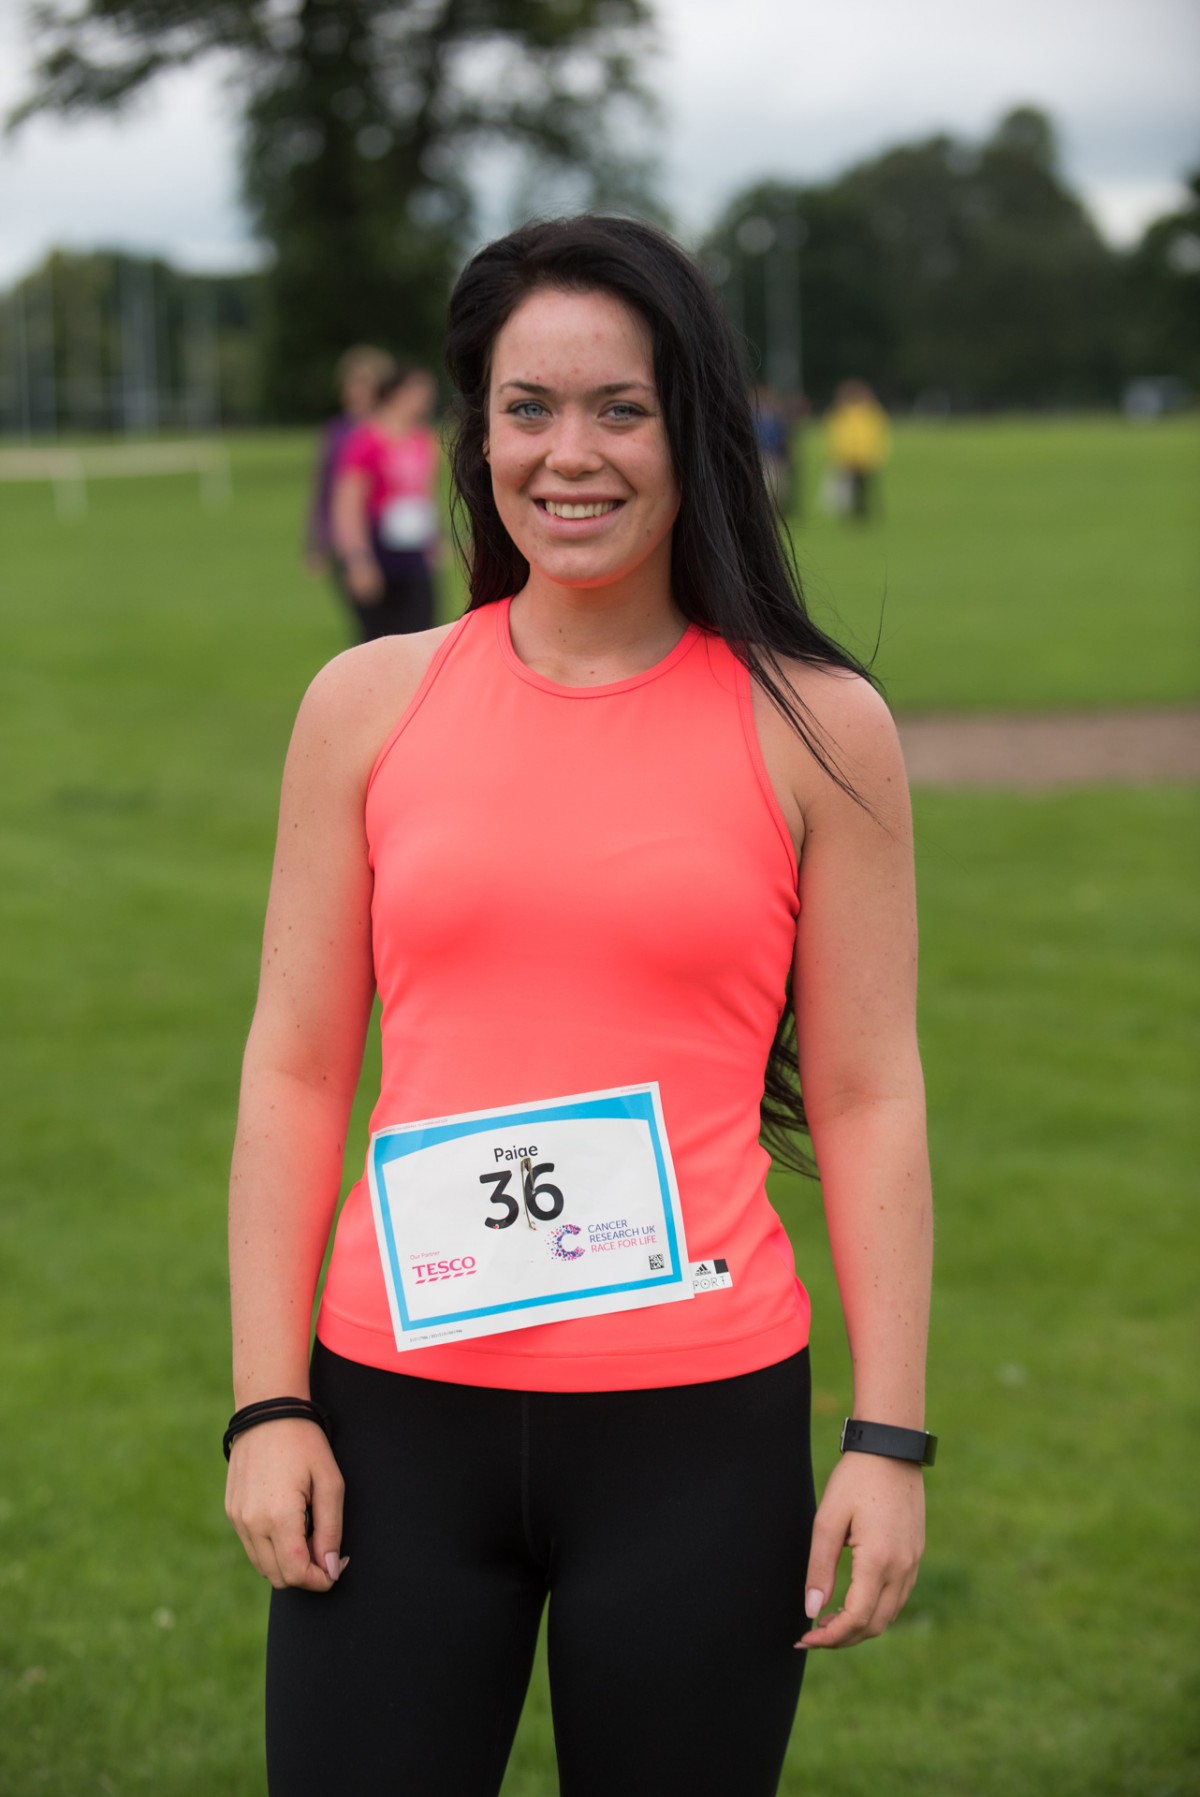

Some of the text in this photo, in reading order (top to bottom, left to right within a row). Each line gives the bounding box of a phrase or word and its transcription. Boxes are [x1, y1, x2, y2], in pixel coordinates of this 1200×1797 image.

[494, 1145, 538, 1162] Paige
[479, 1162, 564, 1229] 36
[587, 1219, 628, 1233] CANCER
[589, 1225, 656, 1243] RESEARCH UK
[591, 1235, 656, 1253] RACE FOR LIFE
[412, 1256, 476, 1277] TESCO
[692, 1275, 725, 1290] PORT
